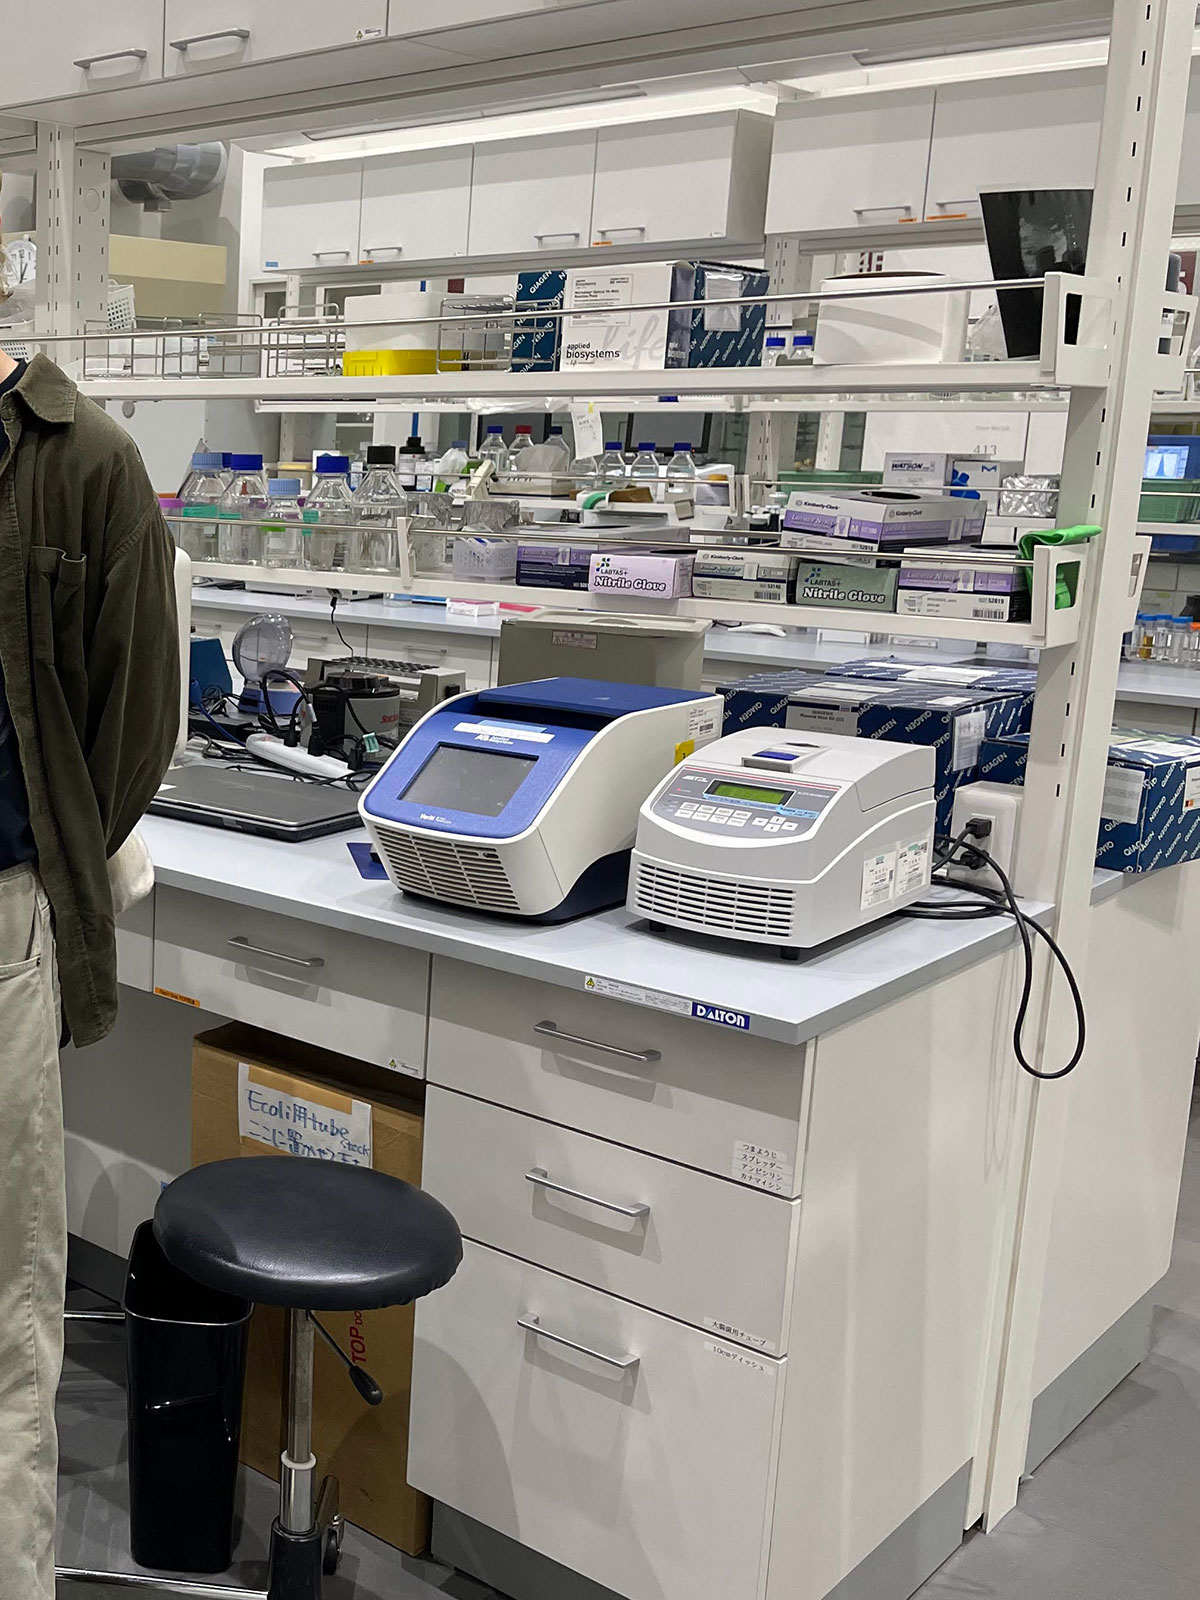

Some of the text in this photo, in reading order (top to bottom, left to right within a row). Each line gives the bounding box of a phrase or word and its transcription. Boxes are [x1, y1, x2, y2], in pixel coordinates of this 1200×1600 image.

[529, 270, 552, 294] QIAGEN
[566, 349, 620, 360] biosystems
[567, 342, 591, 350] applied
[973, 444, 997, 456] 413
[594, 576, 667, 592] Nitrile Glove
[802, 587, 885, 604] Nitrile Glove
[739, 702, 763, 723] QIAGEN
[905, 710, 932, 732] QIAGEN
[871, 718, 897, 739] QIAGEN
[981, 752, 1008, 773] QIAGEN
[1161, 762, 1177, 788] QIAGEN
[1169, 780, 1186, 806] QIAGEN
[1149, 796, 1166, 822] QIAGEN
[696, 1004, 745, 1027] DALTON
[742, 1154, 783, 1169] スプレッダー
[743, 1144, 777, 1159] つまようじ
[741, 1173, 781, 1190] カナマイシン
[742, 1163, 782, 1181] アンピシリン
[349, 1326, 367, 1363] TOP
[713, 1345, 765, 1371] 10cmディッシュ
